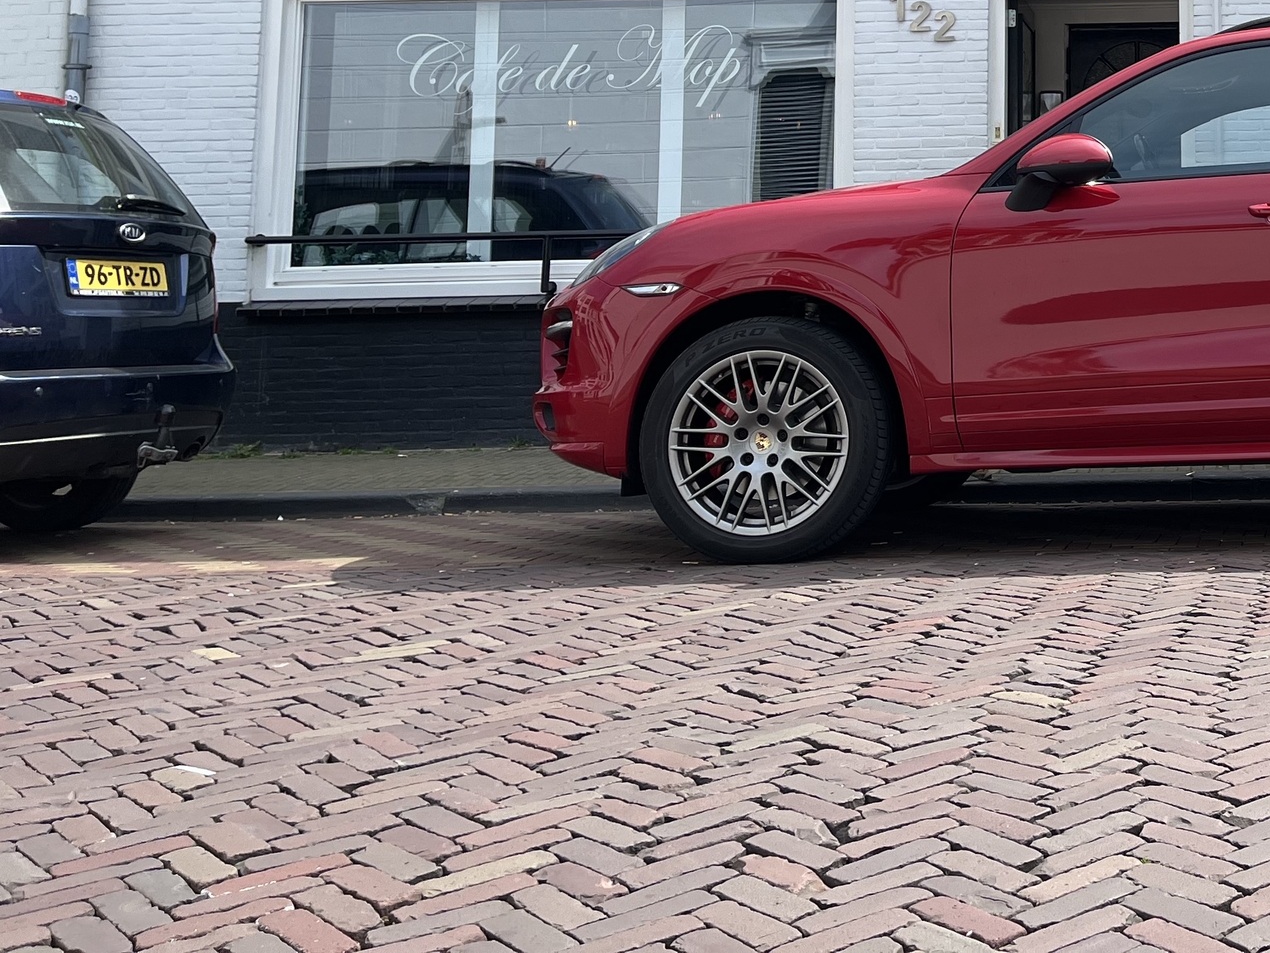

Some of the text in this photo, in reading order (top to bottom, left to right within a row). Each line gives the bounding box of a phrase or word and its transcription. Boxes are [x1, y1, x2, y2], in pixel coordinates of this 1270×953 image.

[535, 44, 592, 90] de
[606, 24, 741, 108] Mop
[70, 276, 78, 284] NL
[85, 263, 161, 287] 96-TR-ZD
[702, 327, 766, 354] ZERO
